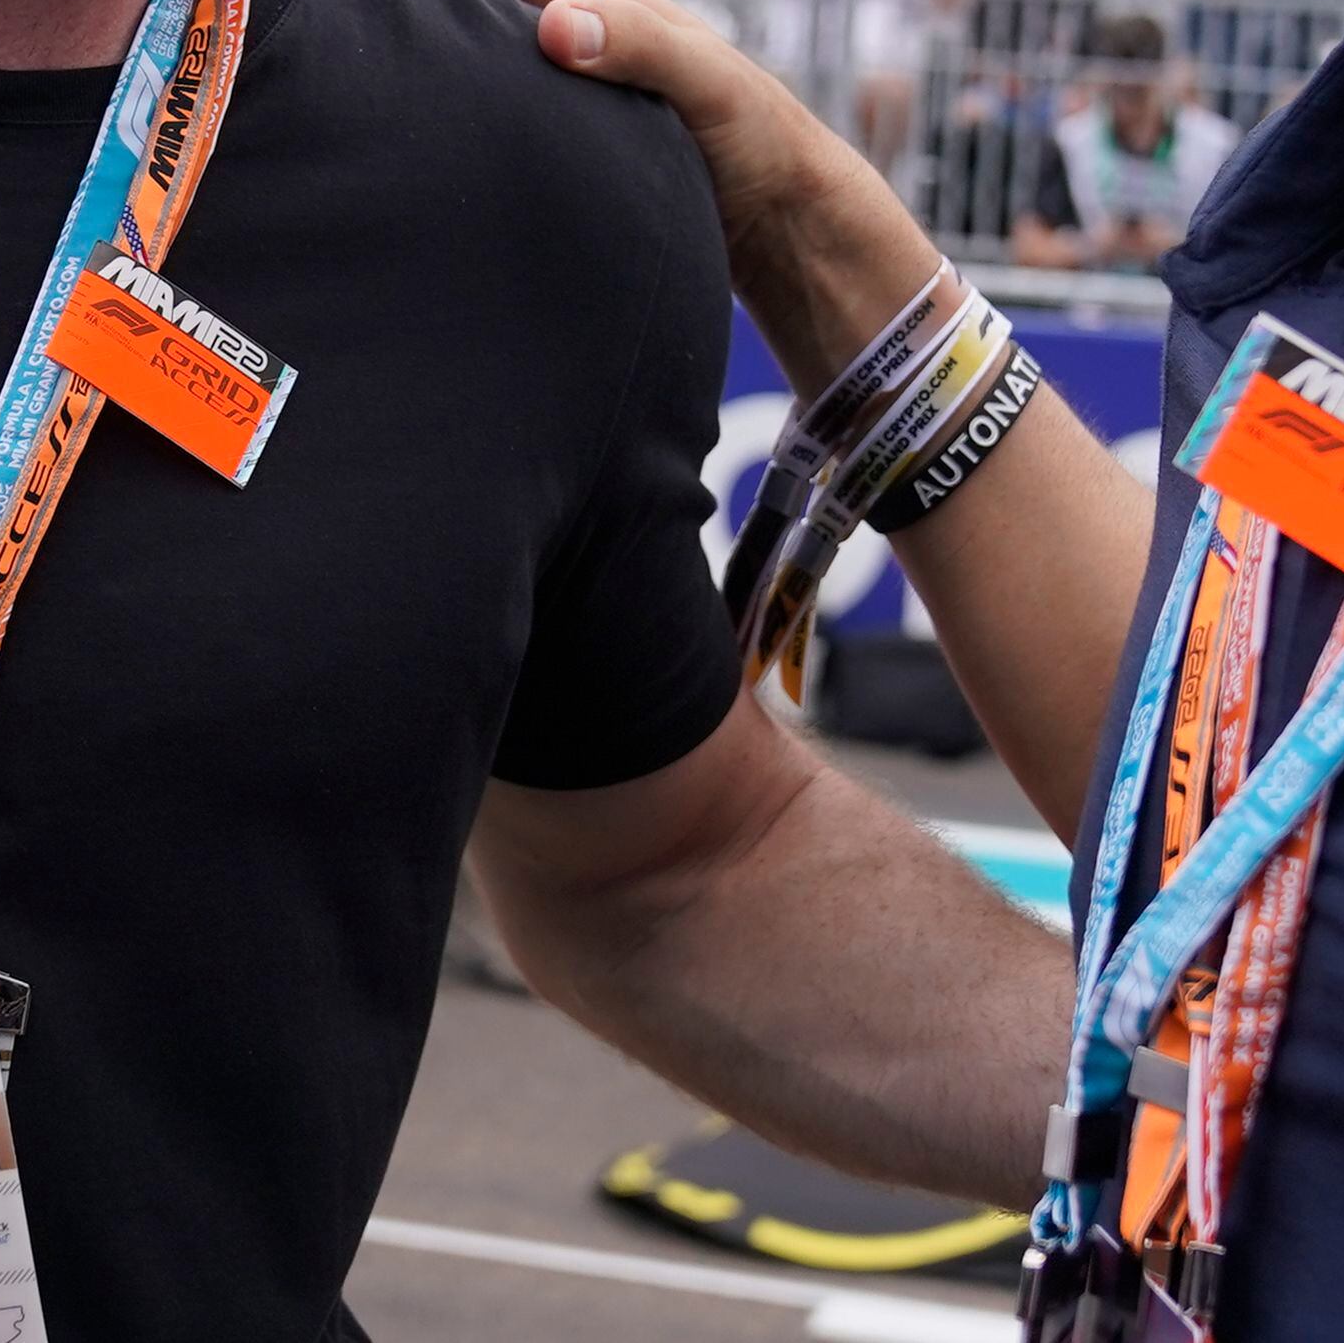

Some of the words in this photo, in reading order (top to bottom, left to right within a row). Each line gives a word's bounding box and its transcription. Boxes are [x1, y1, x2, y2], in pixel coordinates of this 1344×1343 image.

[97, 255, 270, 384] MIAMI22
[856, 299, 936, 382] CRYPTO.COM
[23, 367, 37, 378] 1
[150, 354, 259, 427] ACCESS
[160, 336, 260, 414] GRID
[881, 343, 914, 379] PRIX
[883, 356, 958, 444] CRYPTO.COM
[7, 418, 39, 470] MIAMI
[29, 358, 57, 415] GRAN
[869, 438, 911, 483] GRAND
[910, 405, 939, 439] PRIX
[1179, 621, 1212, 730] 2022
